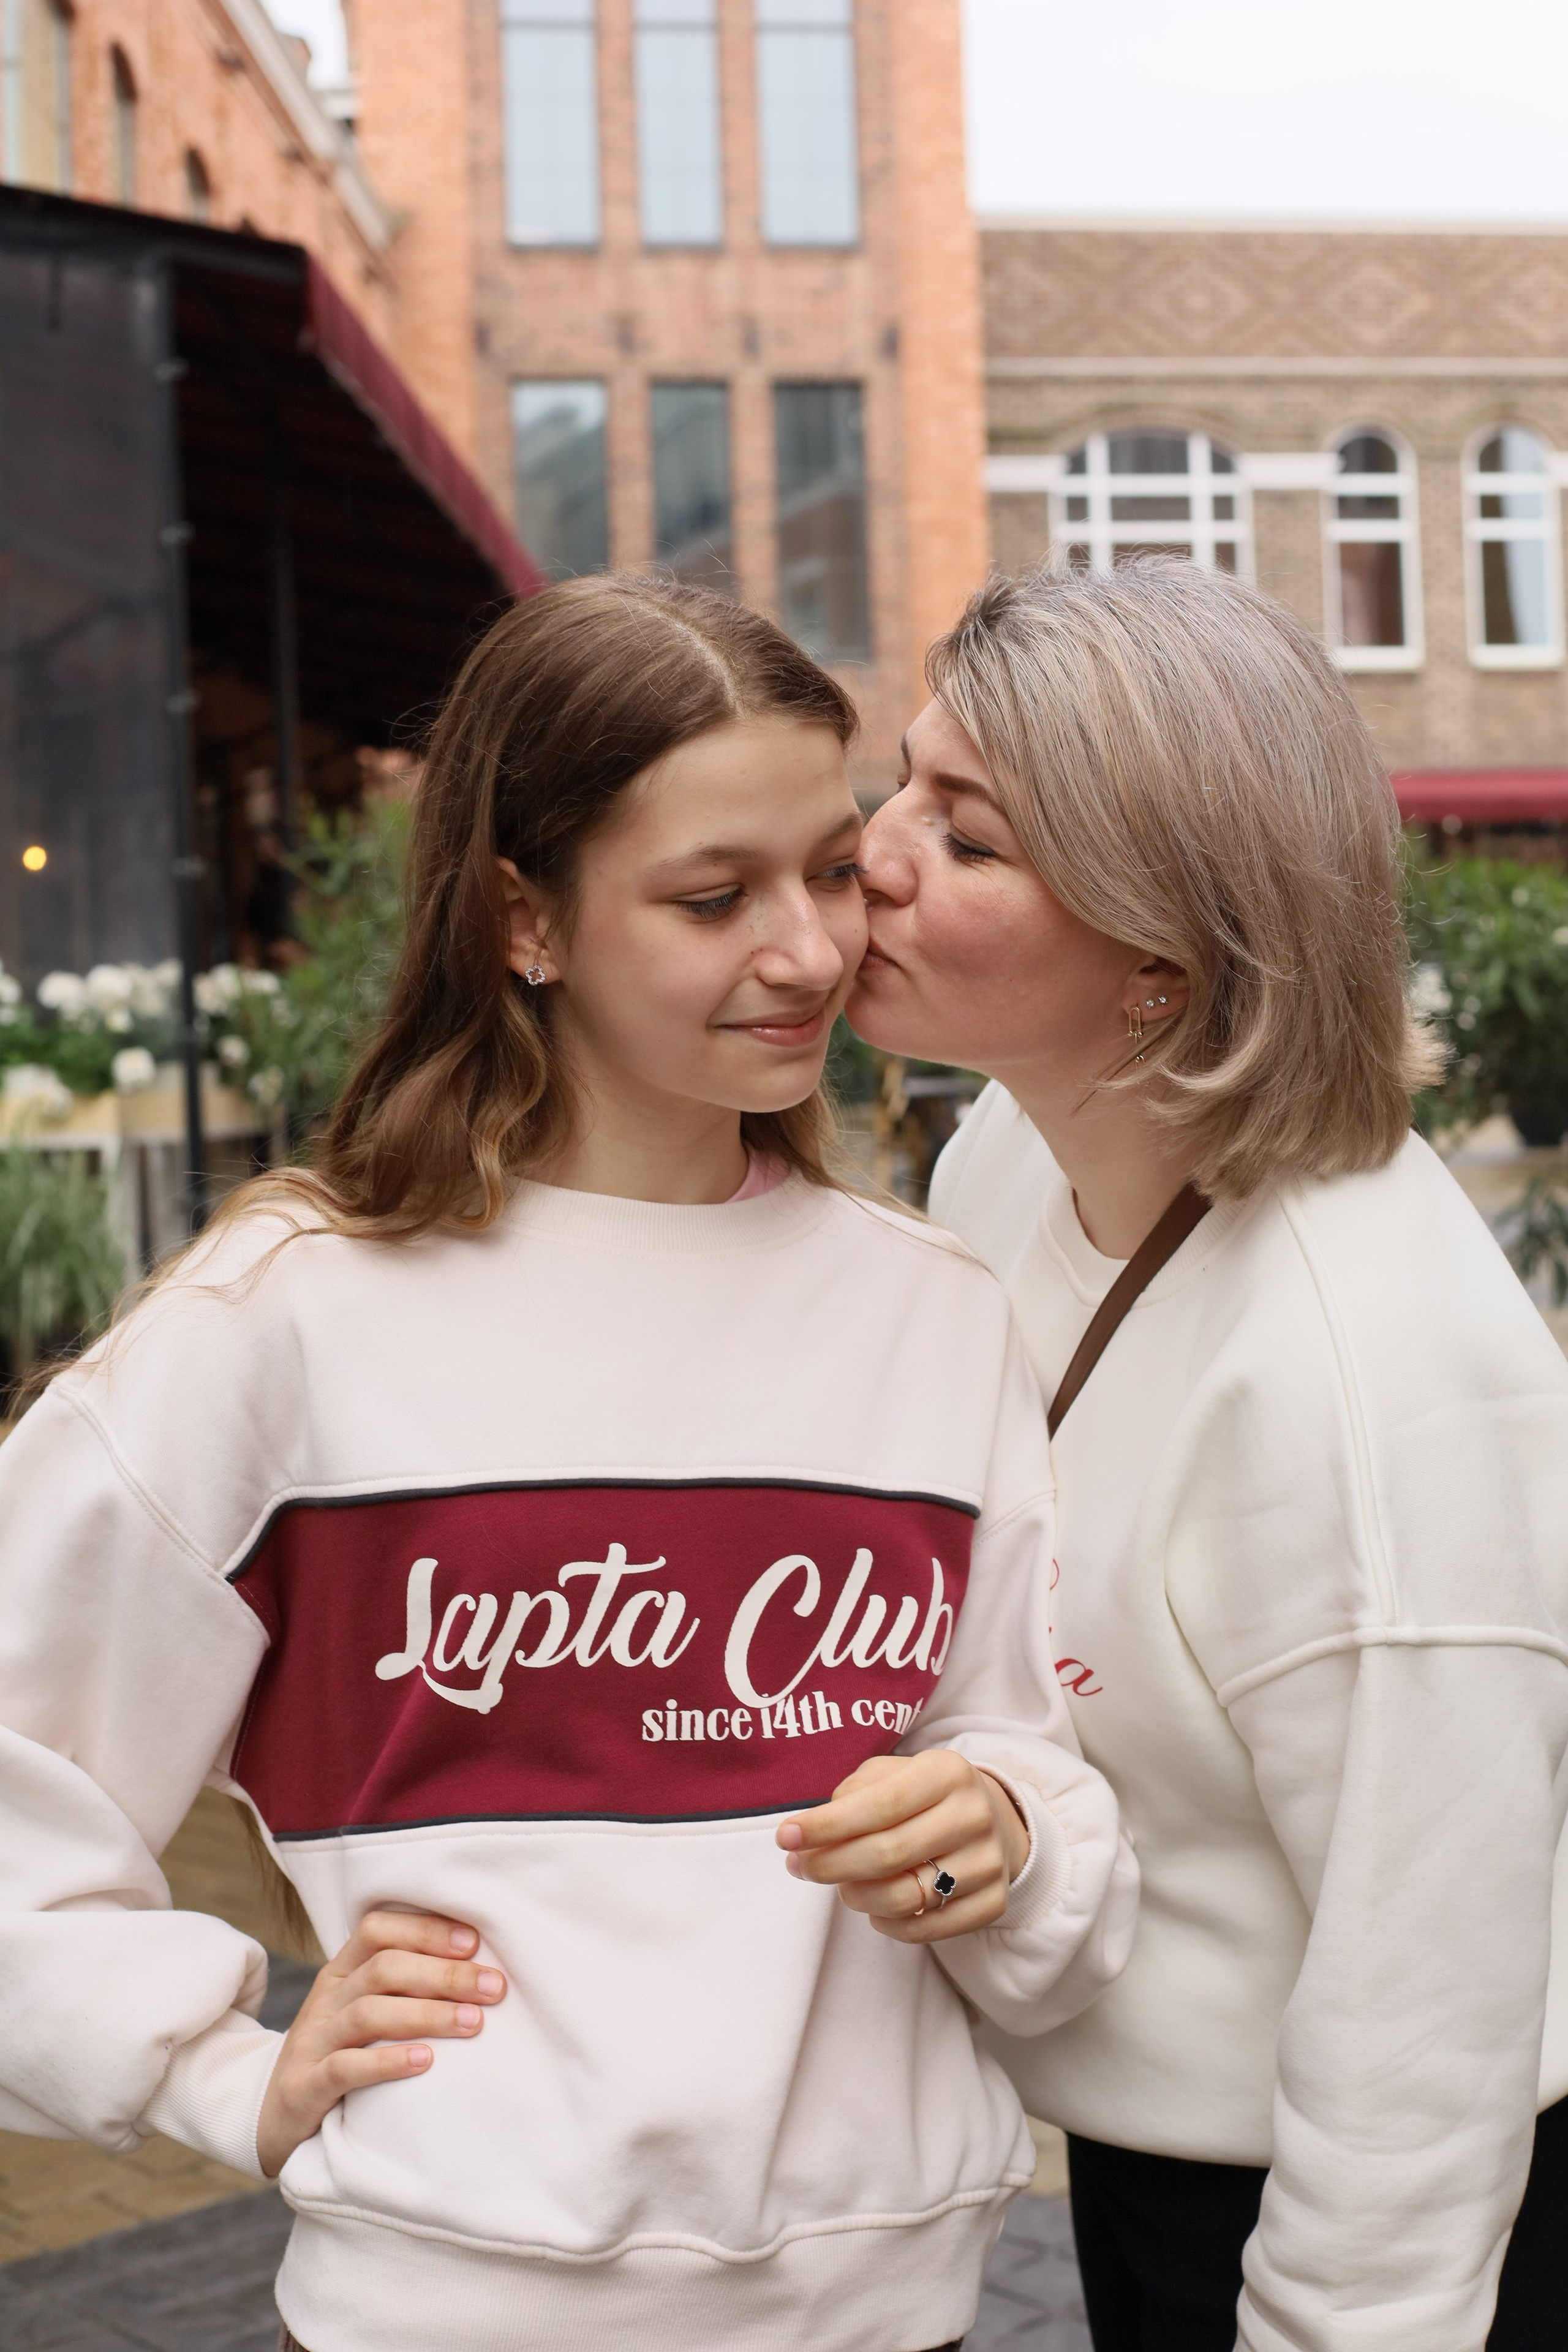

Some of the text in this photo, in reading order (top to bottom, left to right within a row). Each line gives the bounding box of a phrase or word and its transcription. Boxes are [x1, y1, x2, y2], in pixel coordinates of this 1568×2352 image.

[375, 1542, 954, 1714] Lapta Club
[642, 1698, 753, 1742] since
[761, 1691, 844, 1740] 14th
